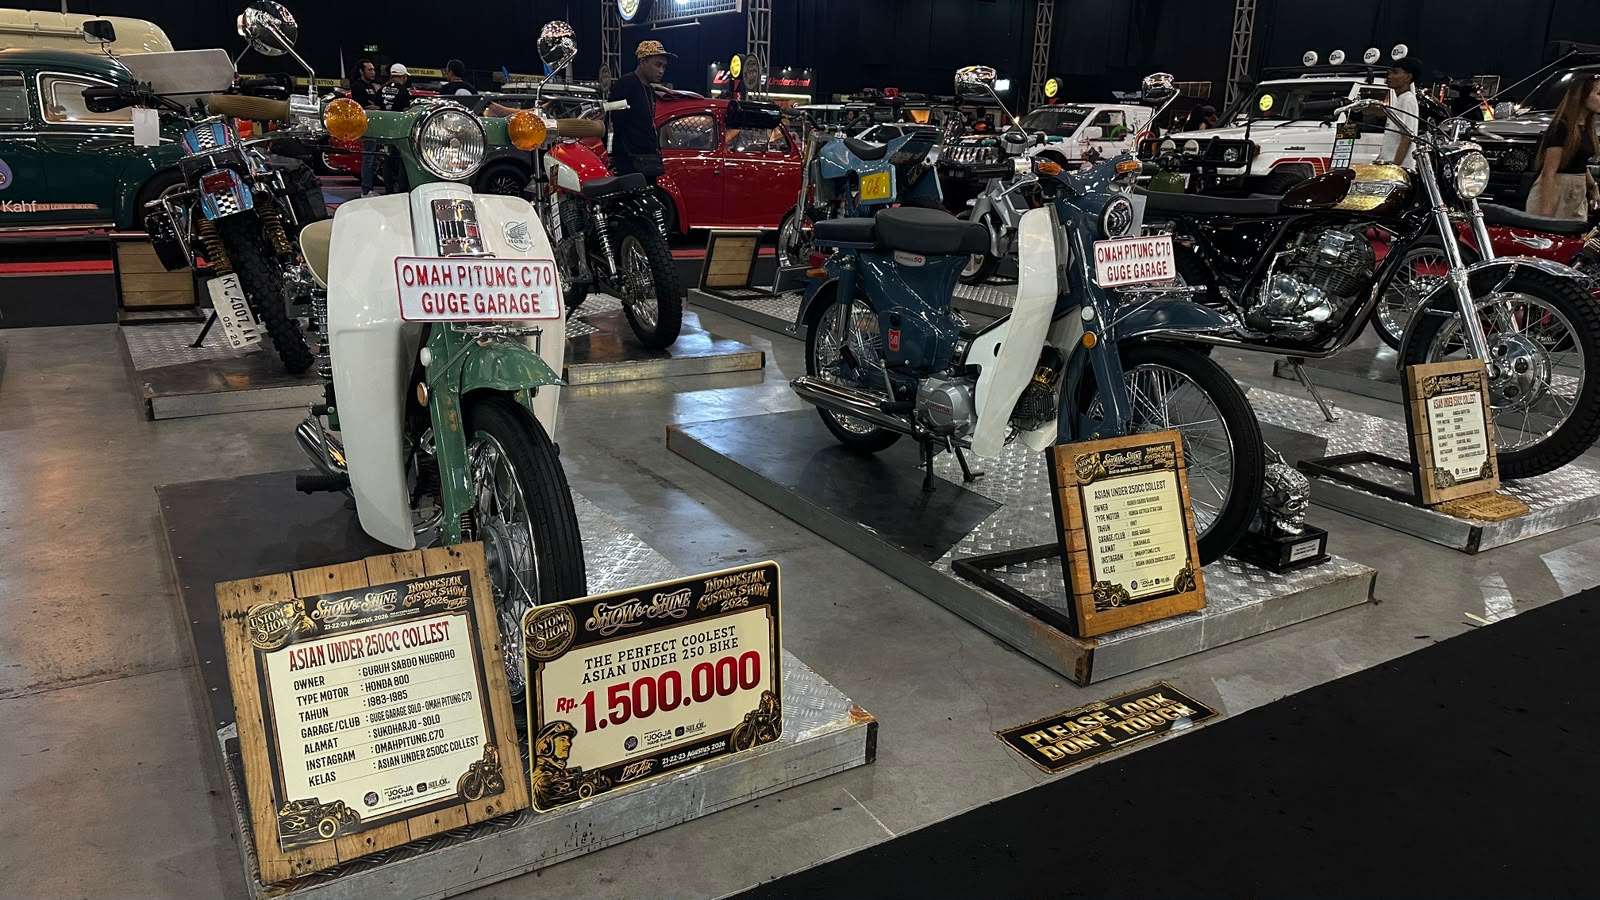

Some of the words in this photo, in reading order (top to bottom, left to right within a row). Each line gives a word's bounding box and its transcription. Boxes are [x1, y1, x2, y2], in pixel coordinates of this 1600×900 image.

[2, 200, 36, 212] Kahf
[1097, 246, 1123, 263] OMAH
[1124, 242, 1153, 260] PITUNG
[1156, 241, 1171, 257] C70
[402, 264, 452, 287] OMAH
[457, 265, 517, 287] PITUNG
[521, 266, 551, 287] C70
[1107, 264, 1132, 282] GUGE
[1134, 261, 1168, 278] GARAGE
[421, 292, 470, 315] GUGE
[474, 293, 541, 314] GARAGE
[1094, 489, 1111, 500] ASIAN
[1111, 486, 1129, 498] UNDER
[1128, 484, 1145, 495] 250CC
[1145, 480, 1166, 492] COLLEST
[1093, 503, 1108, 513] OWNER
[1096, 514, 1106, 523] TYPE
[1106, 512, 1119, 521] MOTOR
[1097, 524, 1111, 534] TAHUN
[1100, 544, 1115, 553] ALAMAT
[1101, 553, 1124, 564] INSTAGRAM
[1103, 565, 1115, 574] KELAS
[406, 575, 462, 594] INDONESIAN
[704, 570, 766, 593] INDONESIAN
[361, 589, 398, 611] SHINE
[402, 589, 437, 608] CUSTOM
[437, 584, 468, 597] SHOW
[424, 596, 448, 608] 2026
[697, 587, 738, 611] CUSTOM
[738, 582, 771, 597] SHOW
[720, 596, 749, 612] 2026
[349, 616, 373, 627] AGUSTUS
[585, 598, 641, 636] SHOW
[646, 588, 692, 618] SHINE
[525, 612, 566, 637] CUSTOM
[536, 621, 569, 650] SHOW
[289, 644, 326, 672] ASIAN
[327, 638, 364, 664] UNDER
[366, 631, 401, 656] 250CC
[402, 621, 450, 649] COLLEST
[584, 654, 612, 670] THE
[618, 639, 677, 664] PERFECT
[681, 625, 736, 647] COOLEST
[293, 675, 325, 691] OWNER
[362, 662, 390, 677] GURUH
[392, 656, 418, 671] SABDO
[418, 648, 455, 666] NUGROHO
[582, 665, 626, 685] ASIAN
[632, 652, 677, 672] UNDER
[682, 646, 704, 660] 250
[710, 637, 739, 654] BIKE
[296, 693, 319, 707] TYPE
[320, 687, 349, 704] MOTOR
[365, 677, 393, 692] HONDA
[394, 674, 410, 686] 800
[556, 697, 578, 714] Rp.
[580, 650, 760, 733] 1.500.000
[299, 706, 329, 722] TAHUN
[367, 690, 408, 707] 1983-1985
[300, 716, 361, 739] GARAGE/CLUB
[370, 711, 385, 723] GUGE
[385, 706, 407, 720] GARAGE
[407, 702, 421, 714] SOLO
[425, 698, 441, 711] OMAH
[441, 694, 461, 707] PITUNG
[461, 691, 472, 702] C70
[1020, 710, 1117, 748] PLEASE
[1109, 692, 1177, 721] LOOK
[1037, 729, 1117, 761] DON'T
[1113, 702, 1197, 734] TOUCH
[304, 737, 339, 755] ALAMAT
[373, 719, 417, 738] SUKOHARJO
[422, 714, 440, 727] SOLO
[306, 750, 356, 771] INSTAGRAM
[375, 728, 444, 755] OMAHPITUNG.C70
[687, 745, 710, 758] AGUSTUS
[711, 741, 726, 750] 2026
[308, 771, 336, 787] KELAS
[377, 756, 401, 770] ASIAN
[401, 749, 426, 764] UNDER
[426, 743, 449, 758] 250CC
[449, 736, 479, 752] COLLEST
